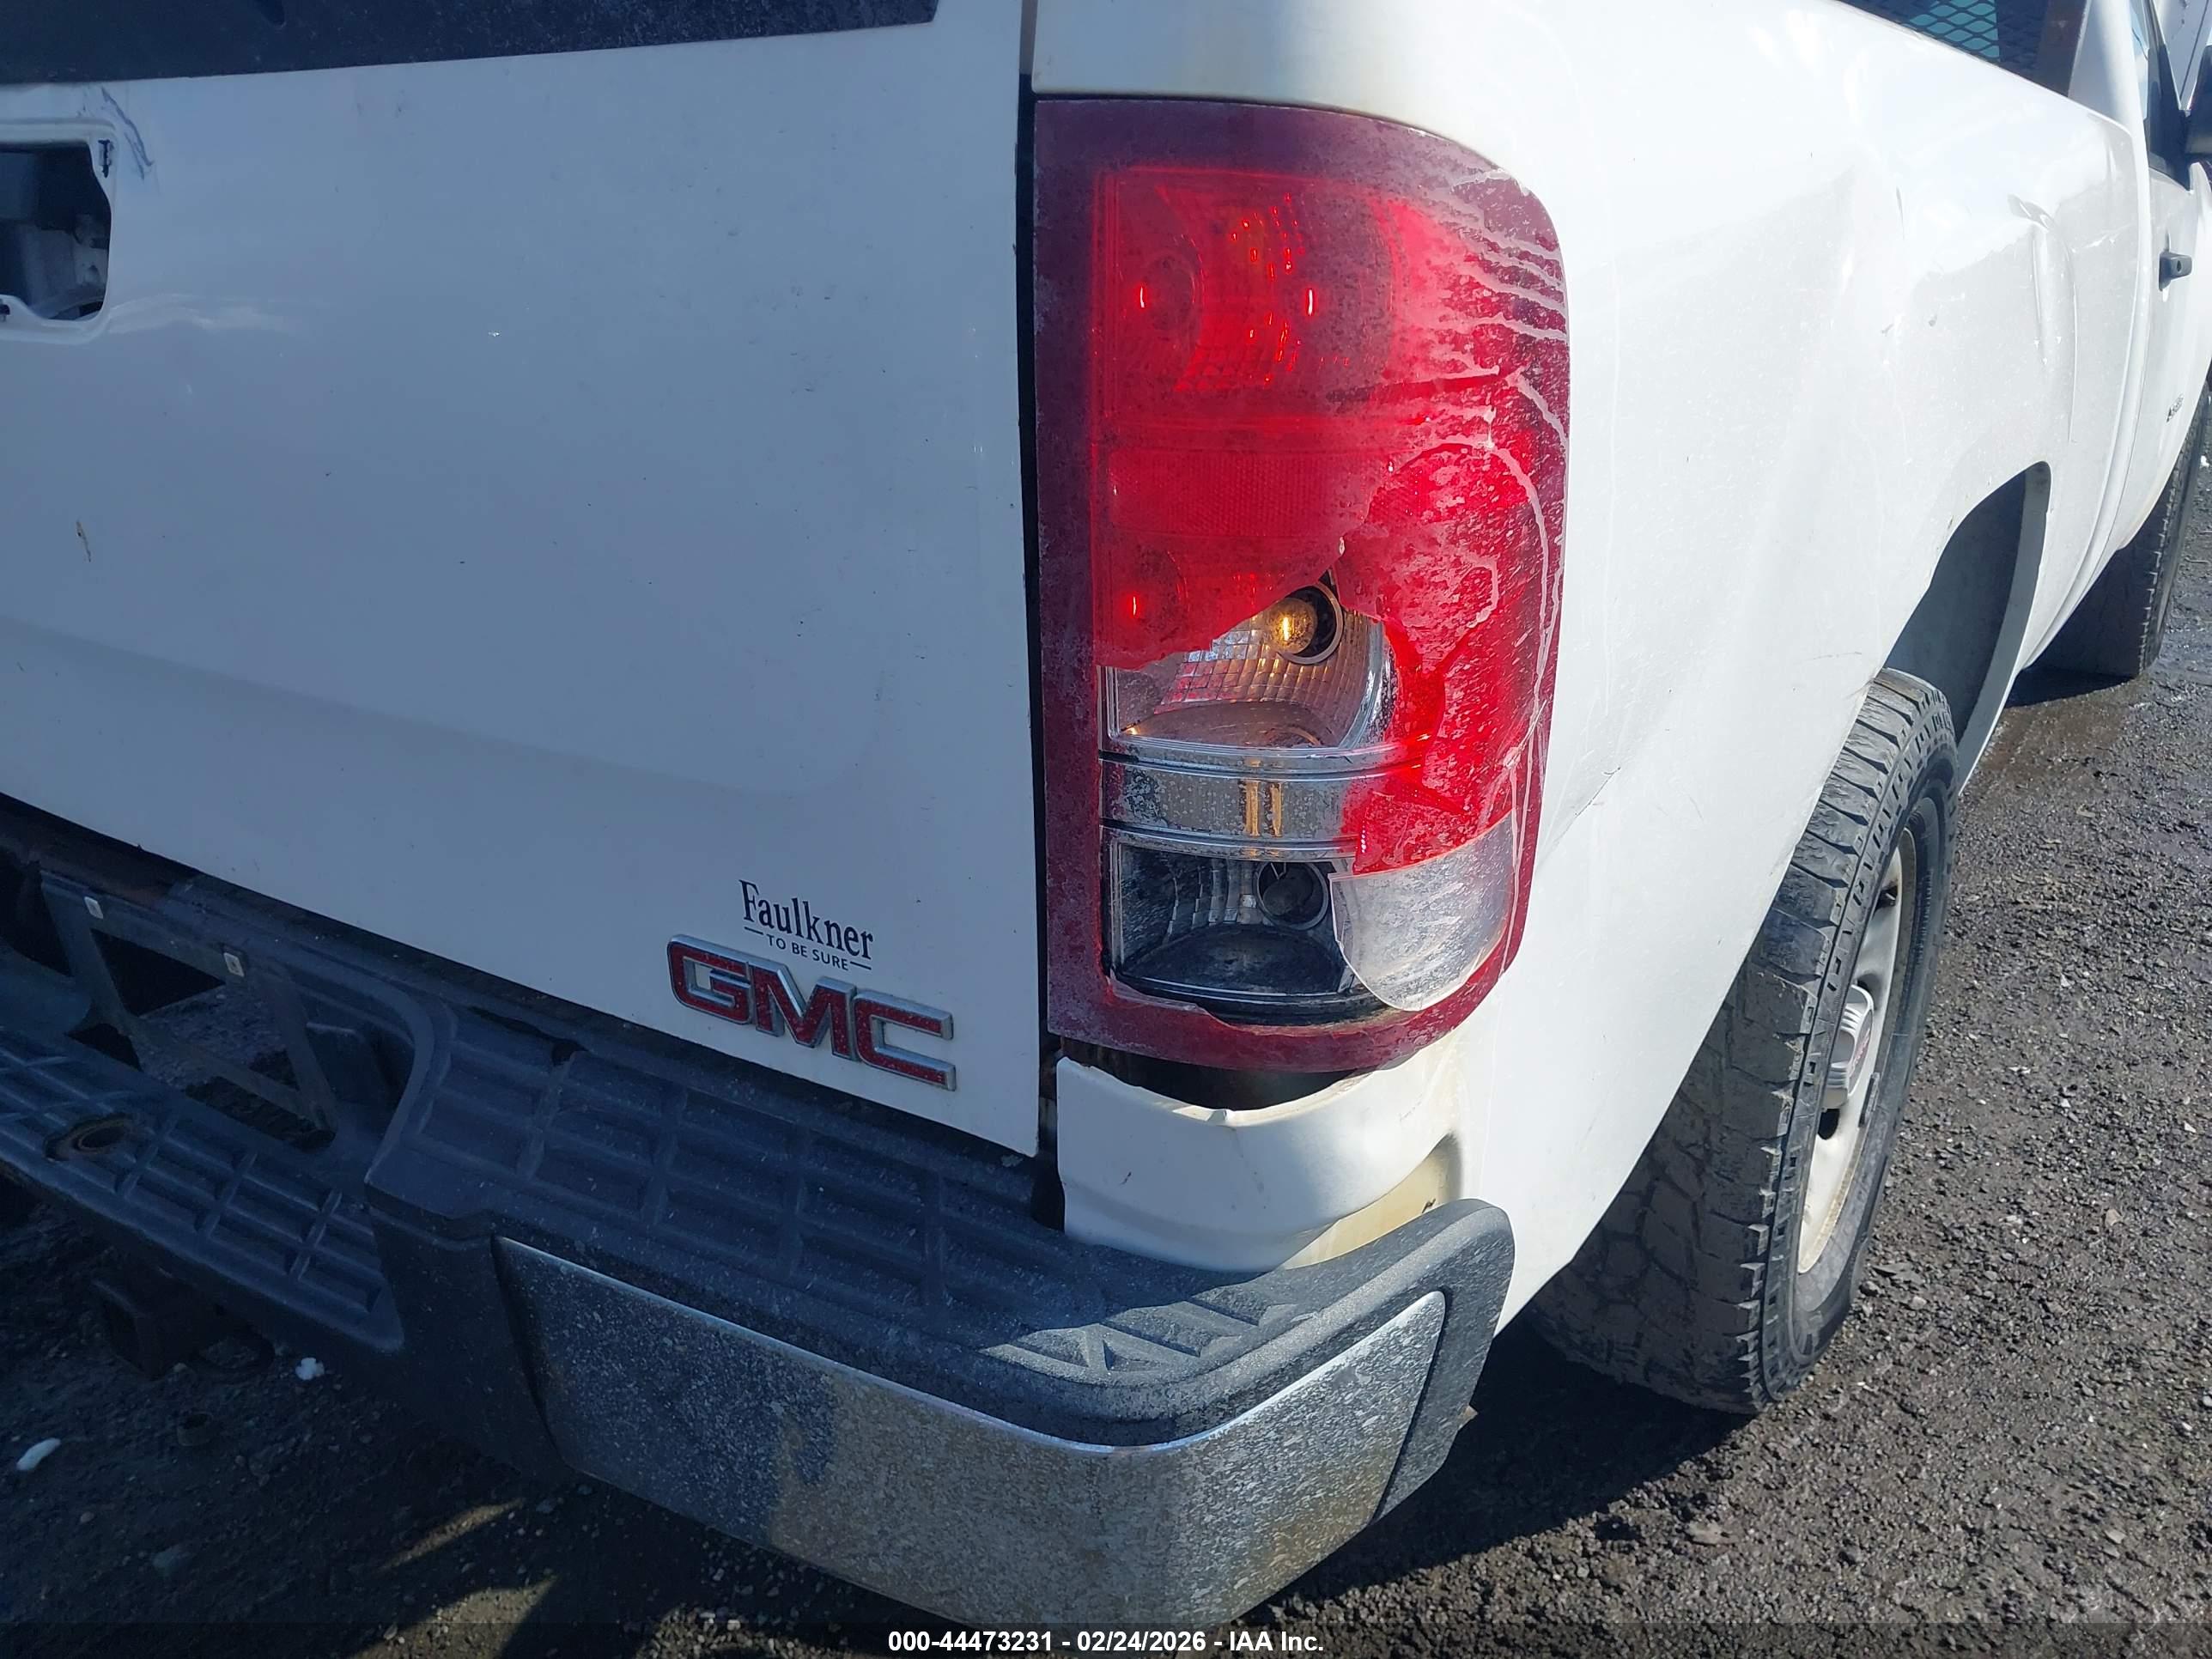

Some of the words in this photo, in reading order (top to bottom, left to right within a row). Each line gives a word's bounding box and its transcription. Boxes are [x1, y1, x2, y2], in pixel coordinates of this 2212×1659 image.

[738, 879, 874, 960] Faulkner
[766, 933, 787, 950] TO
[791, 941, 808, 957] BE
[811, 949, 849, 971] SURE
[666, 933, 957, 1091] GMC
